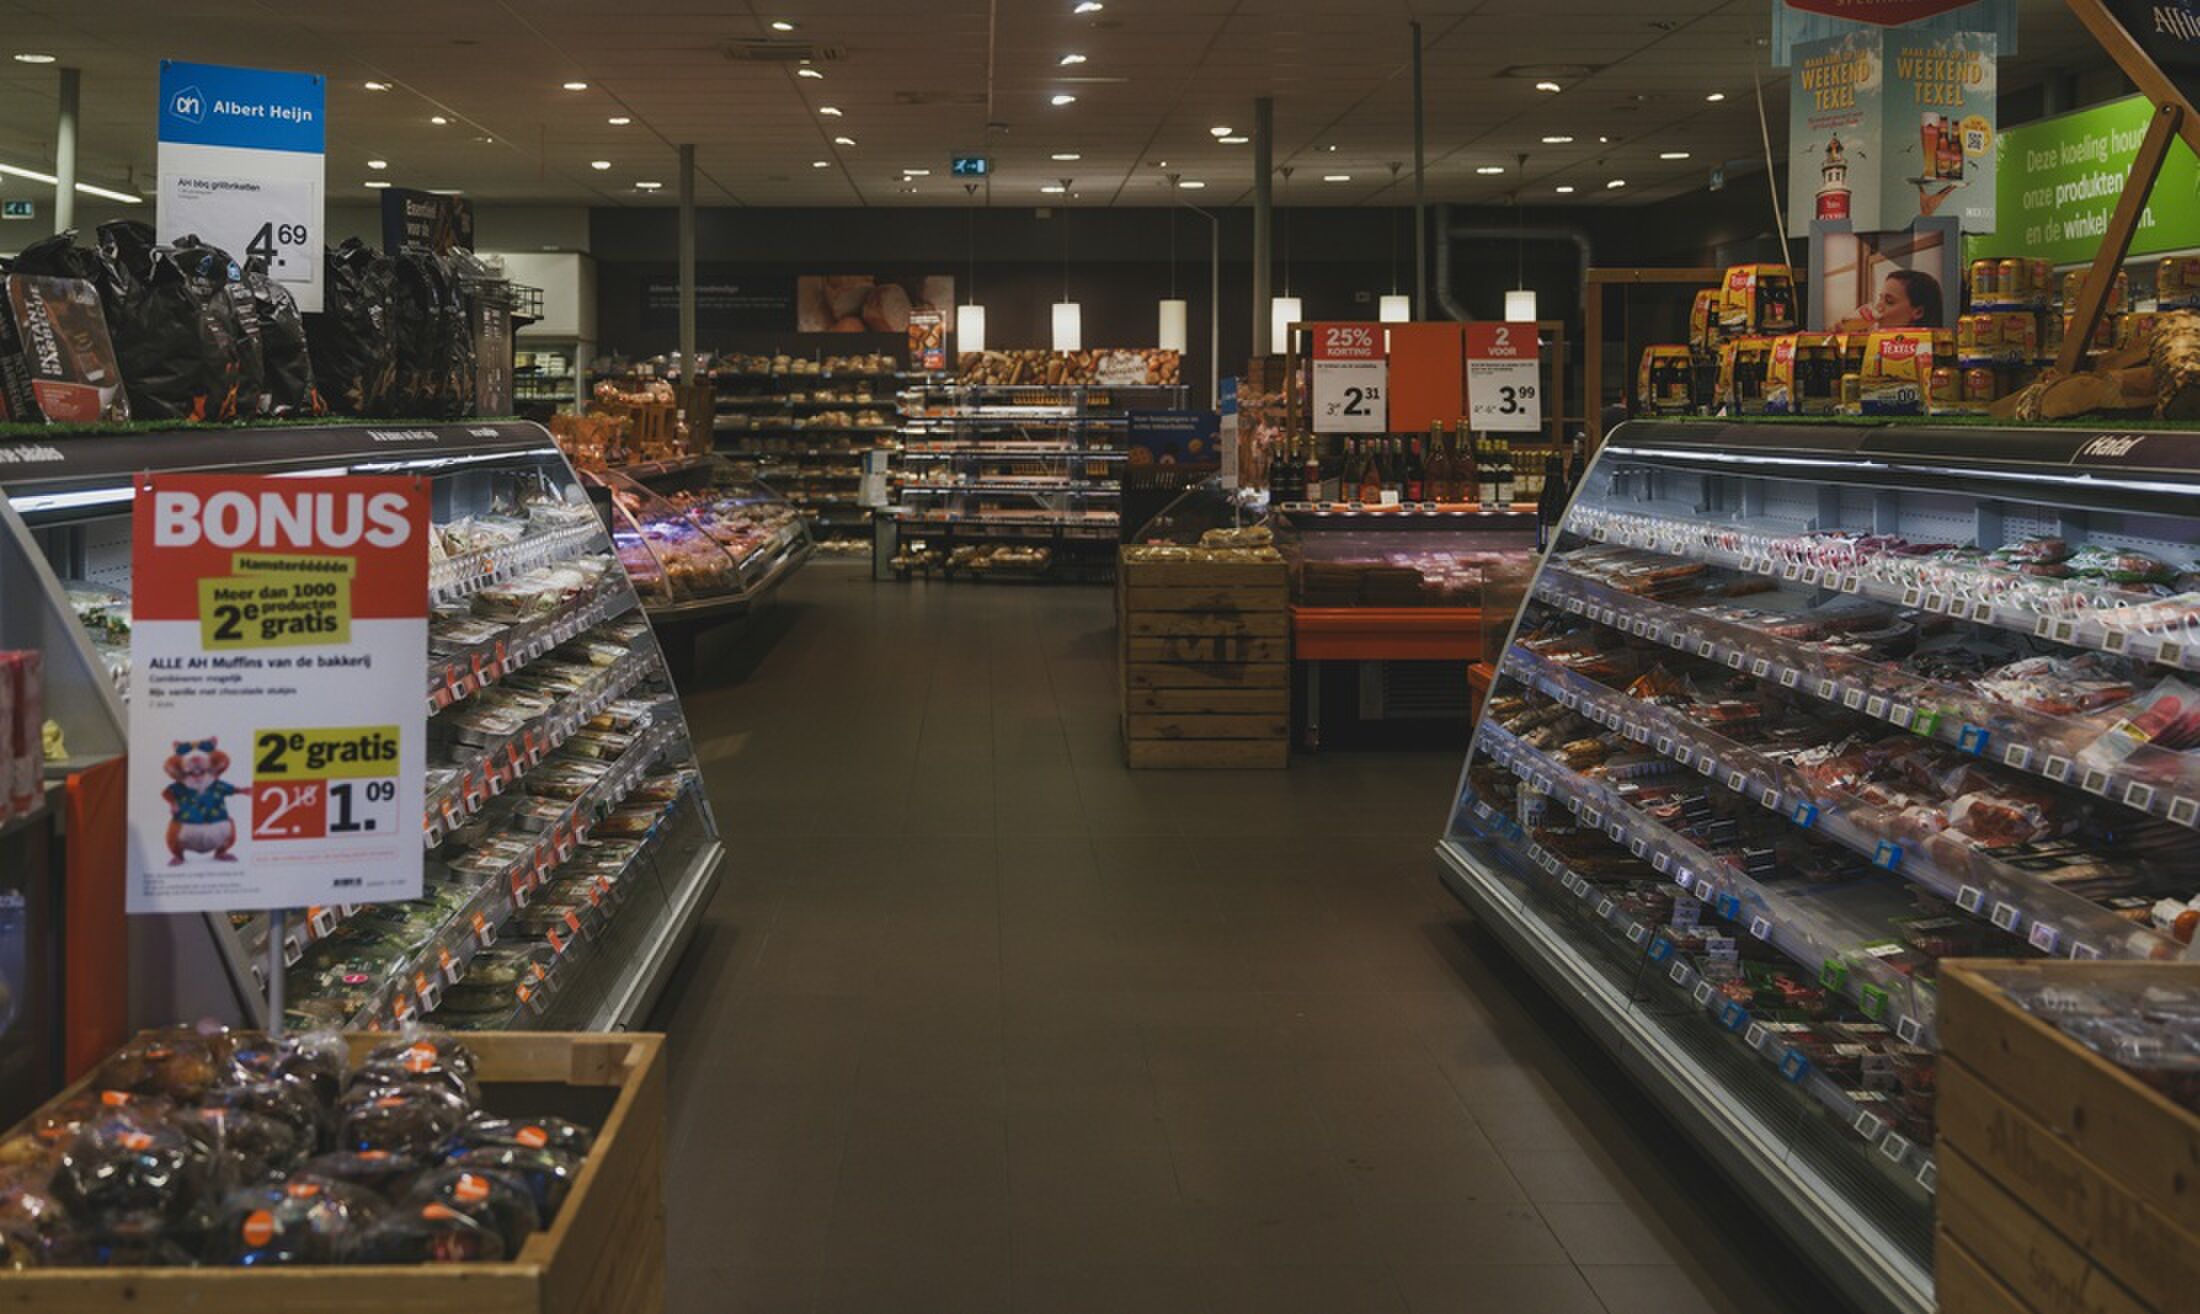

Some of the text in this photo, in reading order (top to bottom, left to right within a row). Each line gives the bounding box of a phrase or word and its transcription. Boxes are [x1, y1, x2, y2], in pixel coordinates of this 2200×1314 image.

[1802, 59, 1870, 92] WEEKEND
[1897, 57, 1982, 85] WEEKEND
[1815, 86, 1856, 112] TEXEL
[1915, 81, 1965, 107] TEXEL
[213, 100, 313, 123] Albert Heijn
[2027, 148, 2057, 173] Deze
[2061, 135, 2108, 166] koeling
[177, 178, 192, 187] AH
[2023, 171, 2124, 209] onze produkten
[2026, 226, 2041, 245] en
[2045, 216, 2061, 243] de
[2064, 207, 2108, 239] winkel
[25, 298, 52, 375] INSTANT
[1327, 327, 1372, 346] 25%
[1495, 327, 1510, 345] 2
[1327, 347, 1372, 357] KORTING
[1488, 346, 1517, 356] VOOR
[155, 491, 411, 548] BONUS
[214, 582, 337, 601] Meer dan 1000
[261, 599, 337, 615] producten
[261, 611, 337, 640] gratis
[149, 654, 371, 669] ALLE AH Muffins van de bakkerij
[306, 734, 397, 769] gratis
